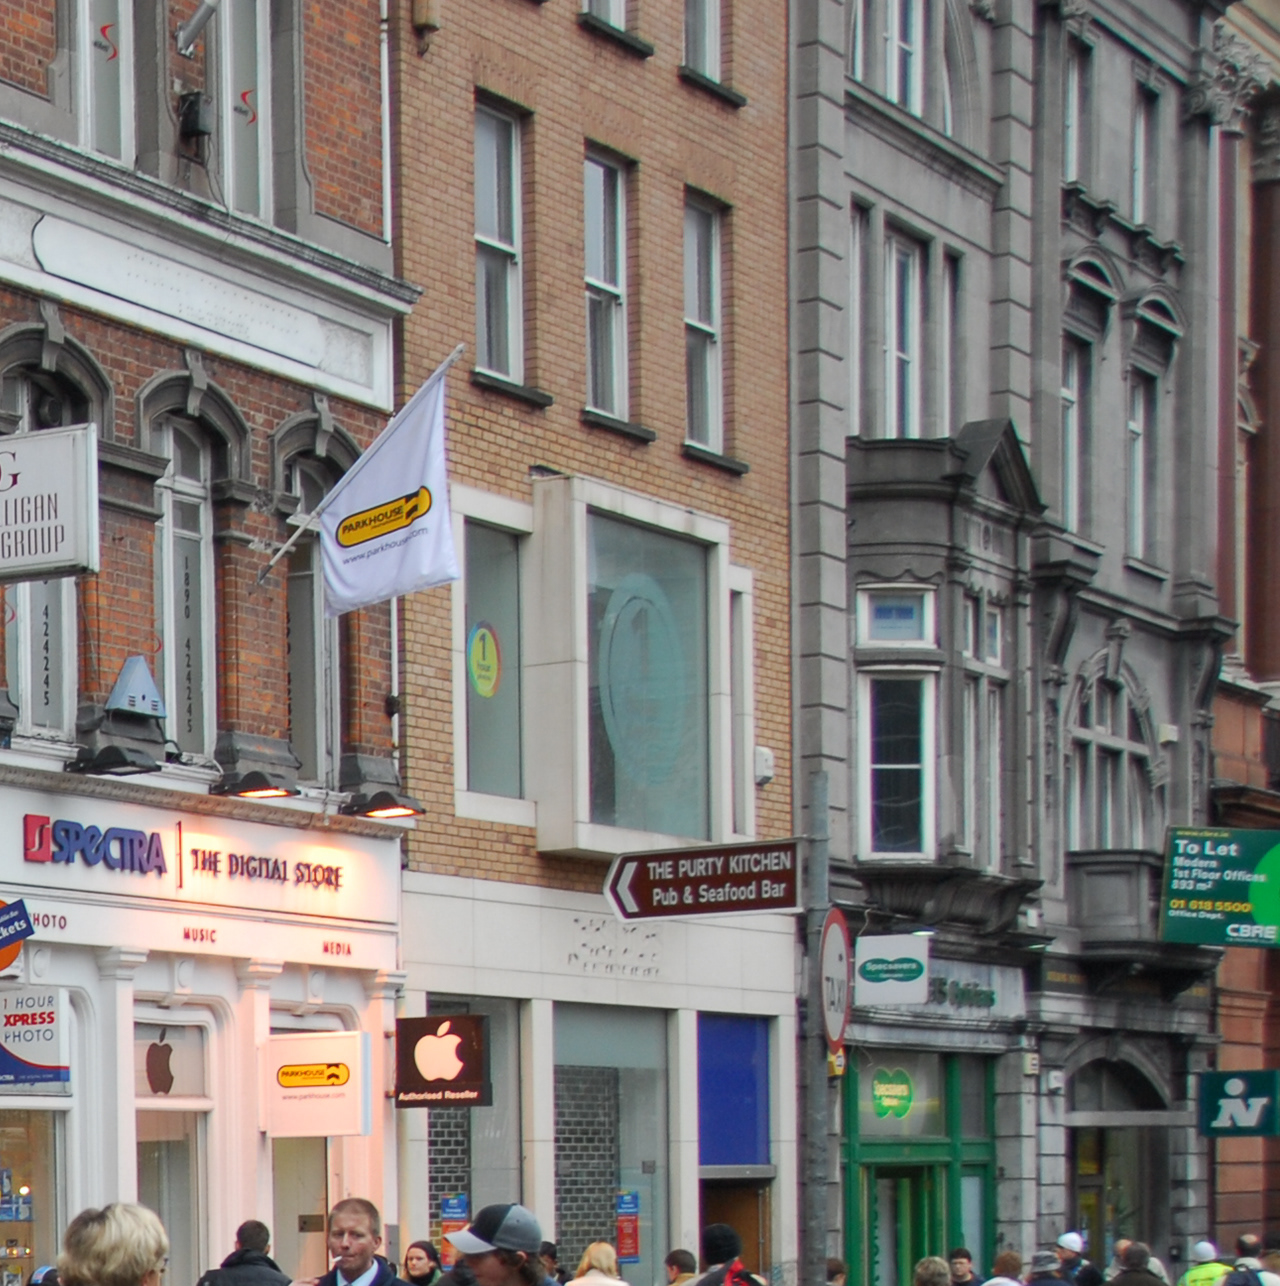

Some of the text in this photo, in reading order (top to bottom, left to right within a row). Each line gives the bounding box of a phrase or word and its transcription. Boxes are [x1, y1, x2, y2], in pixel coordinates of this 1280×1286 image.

[342, 505, 404, 535] PARKHOUSE
[1, 524, 65, 559] GROUP
[342, 527, 428, 565] www.parkhousecom
[479, 632, 487, 661] 1
[42, 605, 50, 706] 424245
[1175, 840, 1239, 856] To Let
[190, 848, 344, 891] THE DIGITAL STORE
[647, 851, 791, 880] THE PURTY KITCHEN
[1173, 857, 1218, 868] Modern
[1173, 868, 1267, 882] 1st Floor Offices
[653, 880, 786, 906] Pub & Seafood Bar
[1169, 899, 1252, 912] 01 618 5500
[29, 912, 67, 930] HOTO
[1168, 910, 1197, 918] Office
[183, 927, 217, 944] MUSIC
[1226, 924, 1277, 938] CBRE
[322, 941, 352, 956] MEDIA
[866, 962, 917, 972] Specsavers
[3, 995, 54, 1010] 1 HOUR
[824, 976, 846, 1013] TAXI
[3, 1011, 55, 1027] XPRESS
[4, 1028, 54, 1044] PHOTO
[281, 1069, 325, 1079] PARKHOUSE
[398, 1090, 478, 1101] Authorised Reseller
